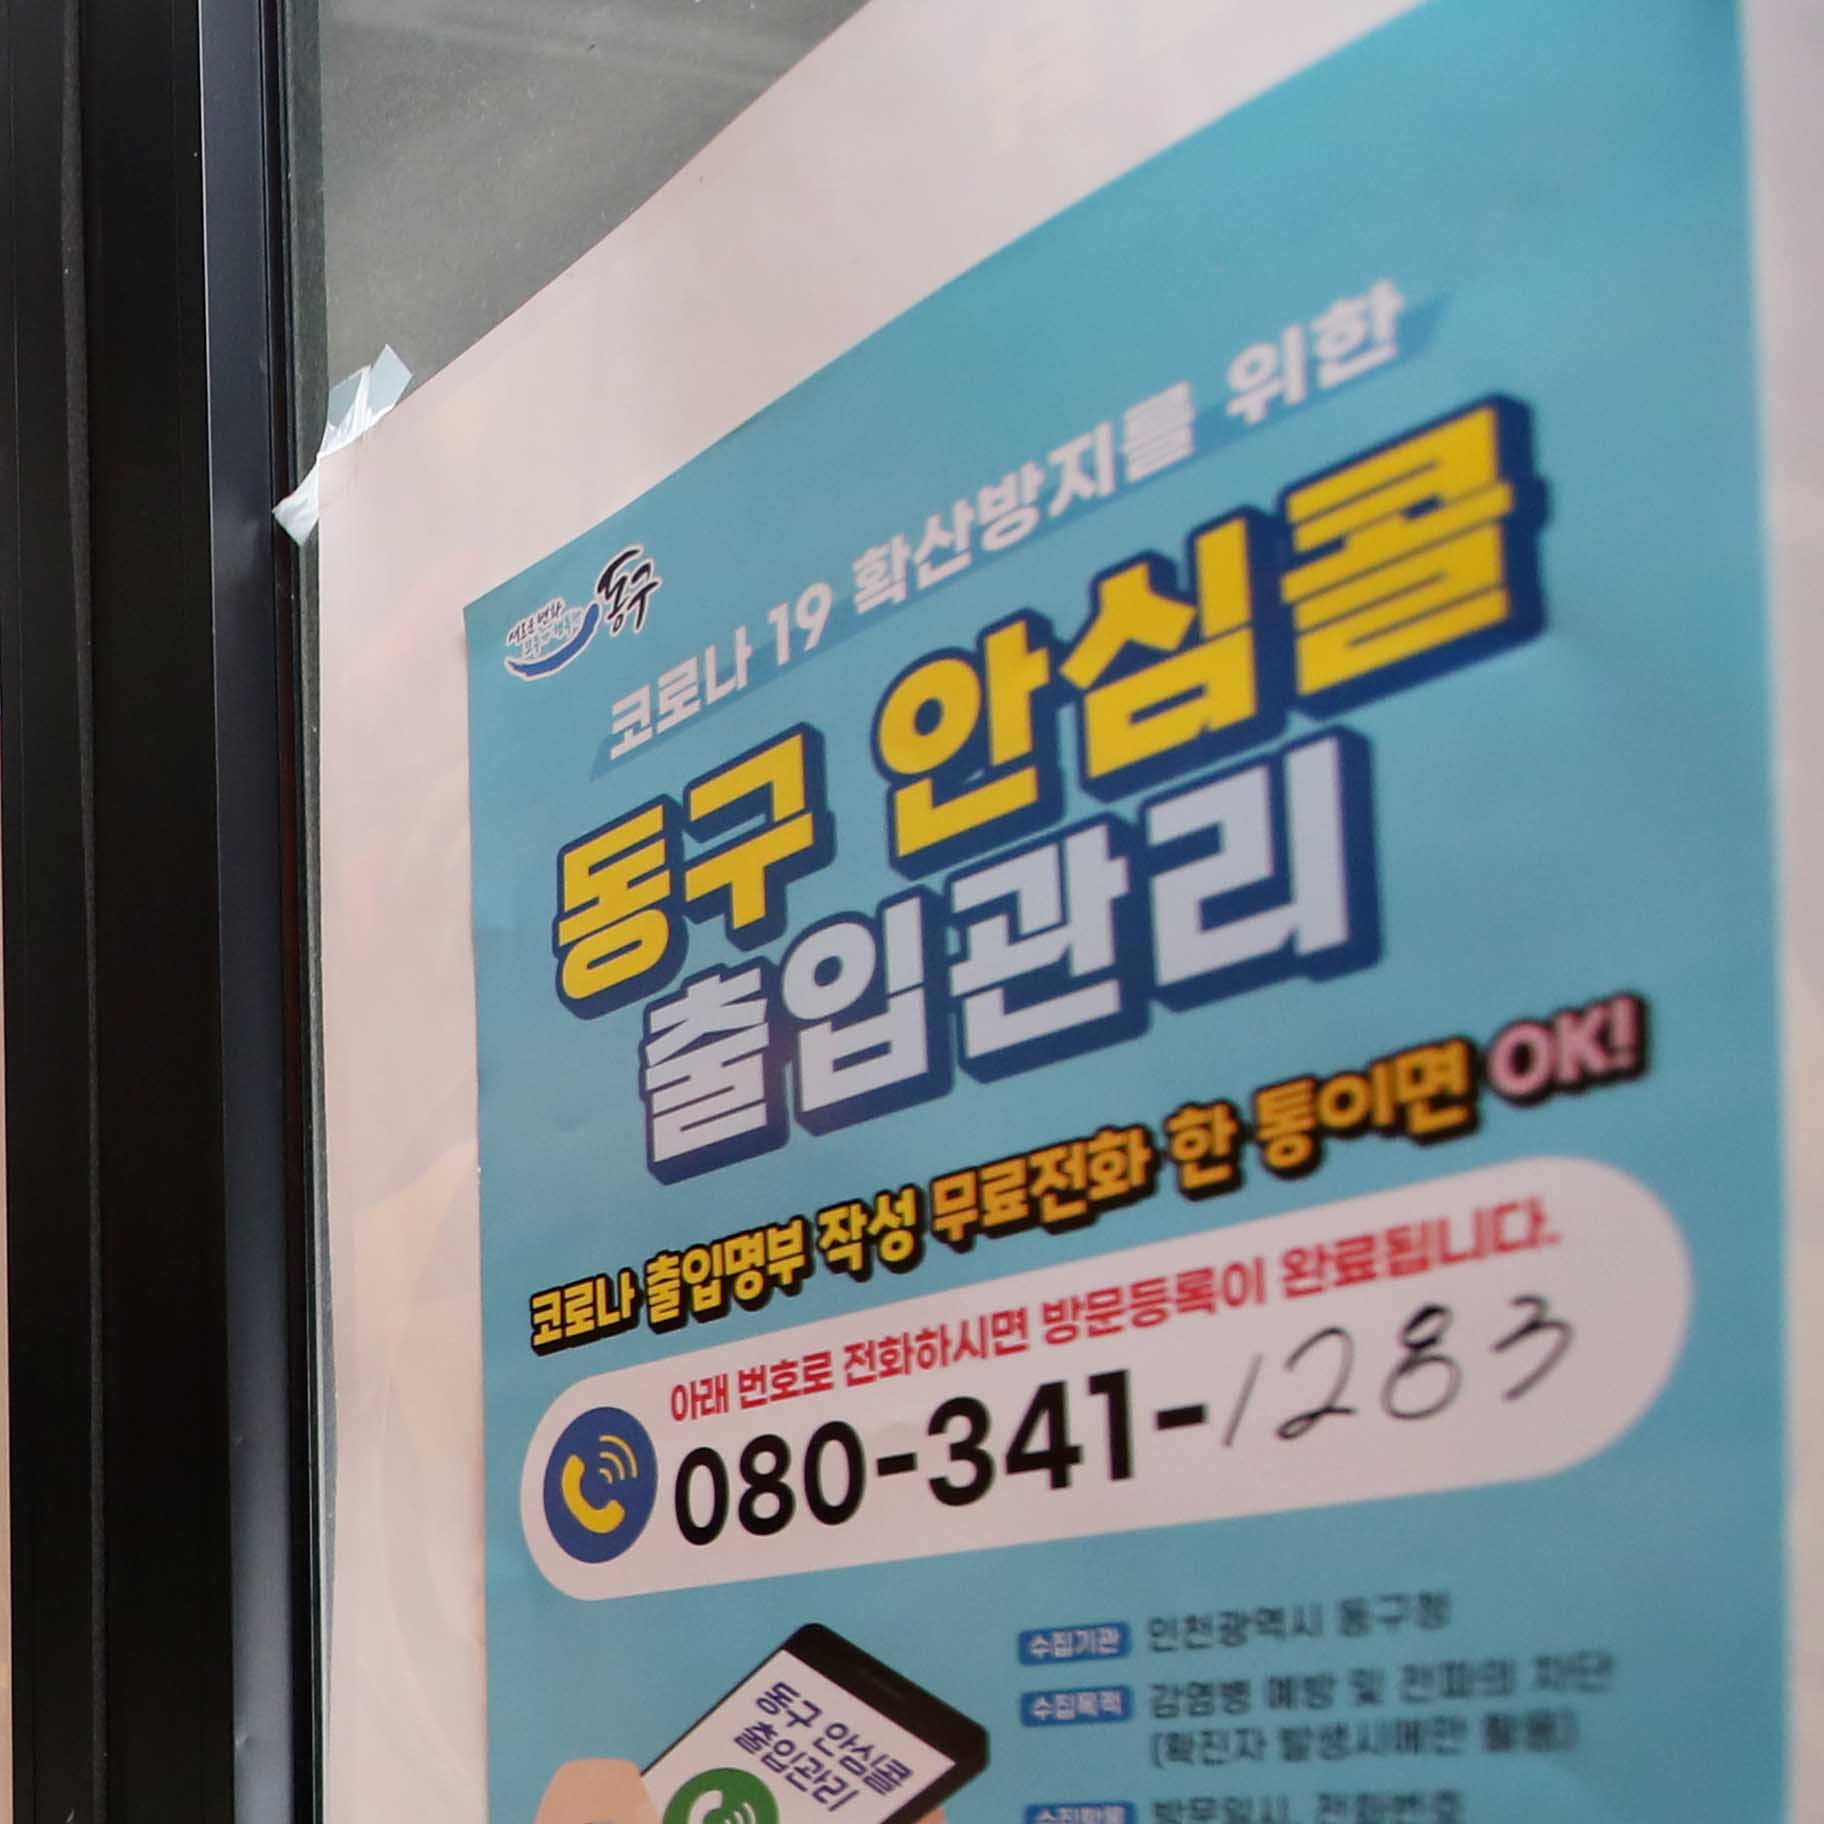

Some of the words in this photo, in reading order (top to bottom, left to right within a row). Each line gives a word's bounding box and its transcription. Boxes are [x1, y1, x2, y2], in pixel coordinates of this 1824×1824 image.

[607, 629, 757, 760] 코로나
[769, 582, 837, 669] 19
[853, 383, 1197, 613] 확산방지를
[1228, 280, 1406, 425] 위한
[555, 732, 827, 1008] 동구
[870, 398, 1532, 865] 안심콜
[640, 750, 1357, 1168] 출입관리
[531, 1273, 637, 1354] 코로나
[645, 1216, 807, 1328] 출입명부
[818, 1186, 921, 1275] 작성
[929, 1125, 1153, 1245] 무료전화
[1166, 1100, 1242, 1199] 한
[1252, 1036, 1473, 1173] 통이면
[1480, 996, 1645, 1102] OK!
[670, 1375, 728, 1425] 아래
[736, 1346, 836, 1407] 번호로
[843, 1307, 1031, 1387] 전화하시면
[1039, 1260, 1266, 1344] 방문등록이
[1282, 1197, 1559, 1298] 완료됩니다.
[731, 1720, 858, 1813] 출입관리
[754, 1681, 821, 1731] 동구
[818, 1724, 914, 1795] 안심콜
[1029, 1631, 1121, 1662] 수집기관
[1147, 1602, 1323, 1654] 인천광역시
[1334, 1590, 1451, 1638] 동구청
